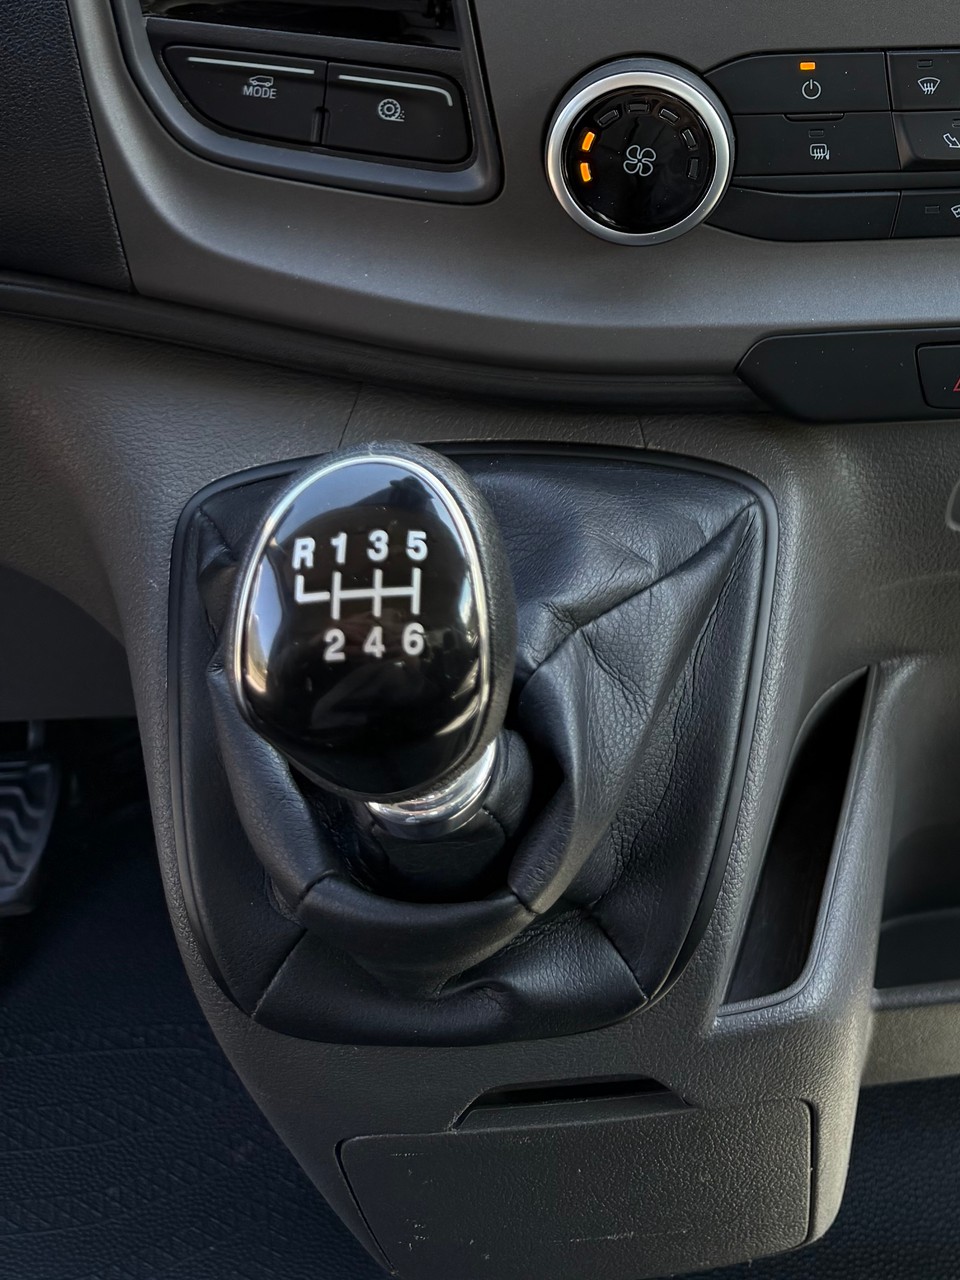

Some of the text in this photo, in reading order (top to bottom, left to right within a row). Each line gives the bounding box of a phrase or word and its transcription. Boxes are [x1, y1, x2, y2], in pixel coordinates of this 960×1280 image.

[242, 85, 277, 99] MODE
[292, 529, 428, 569] R 1 3 5
[323, 622, 425, 662] 2 4 6
